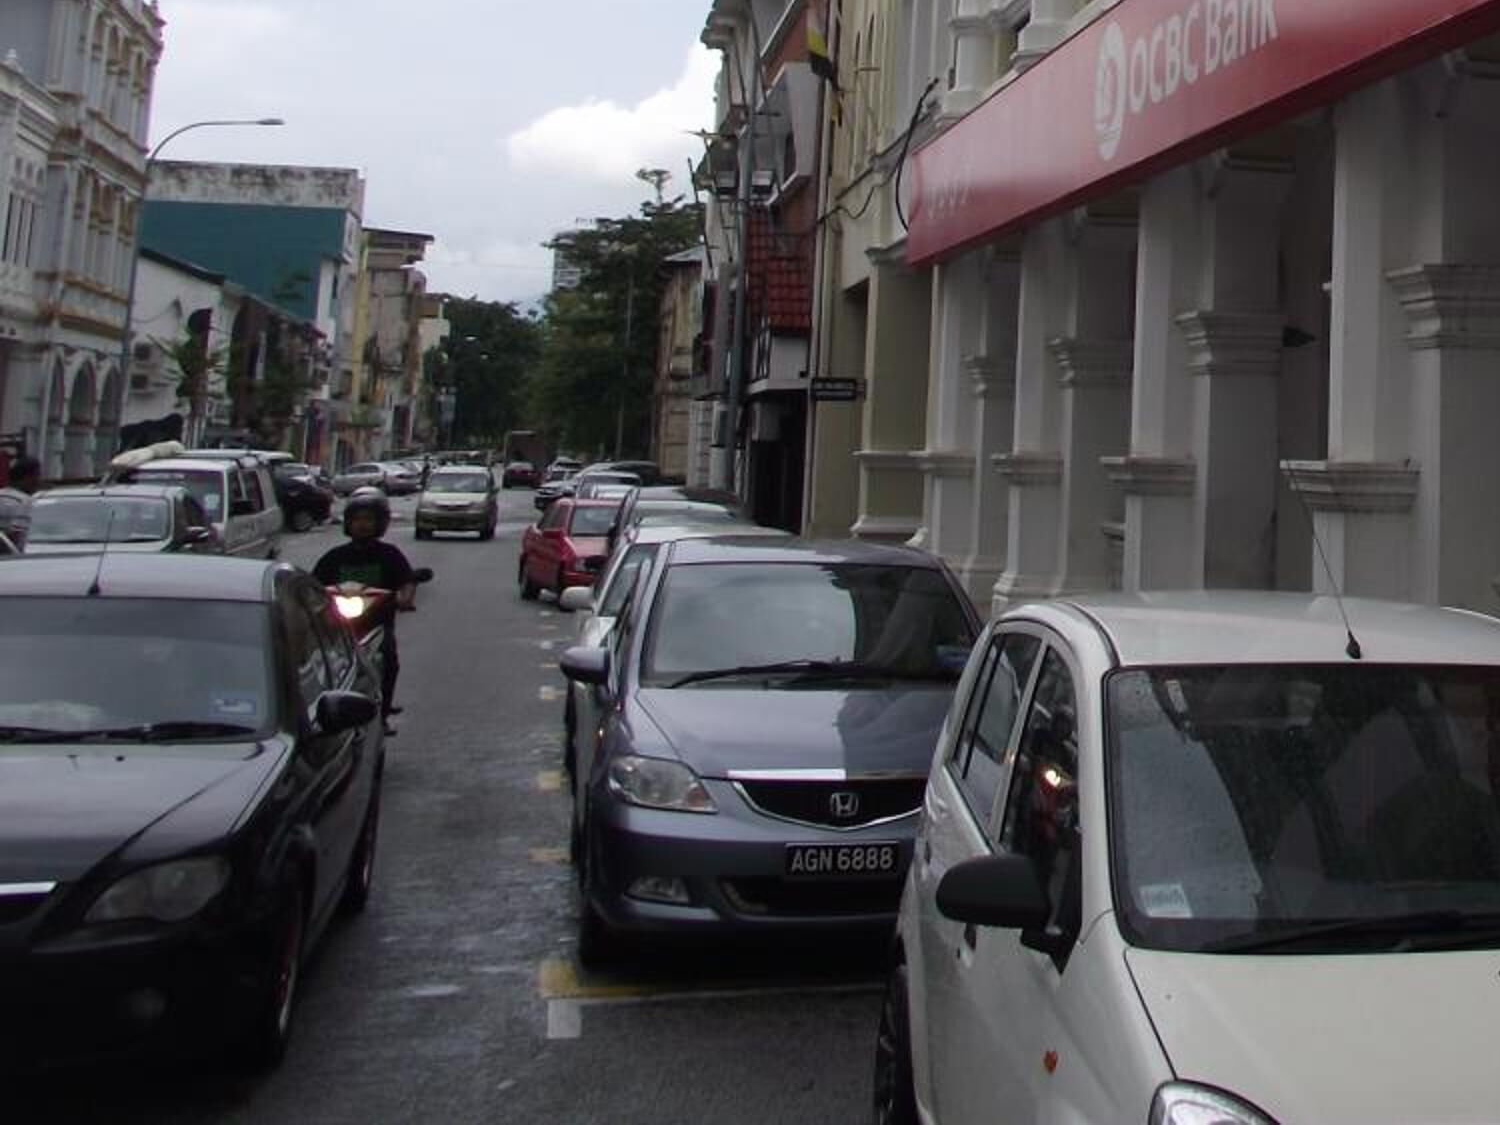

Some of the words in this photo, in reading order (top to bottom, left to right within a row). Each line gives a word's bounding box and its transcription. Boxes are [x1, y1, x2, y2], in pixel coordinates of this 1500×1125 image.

[1129, 0, 1200, 115] OCBC
[791, 847, 833, 872] AGN
[837, 845, 894, 871] 6888
